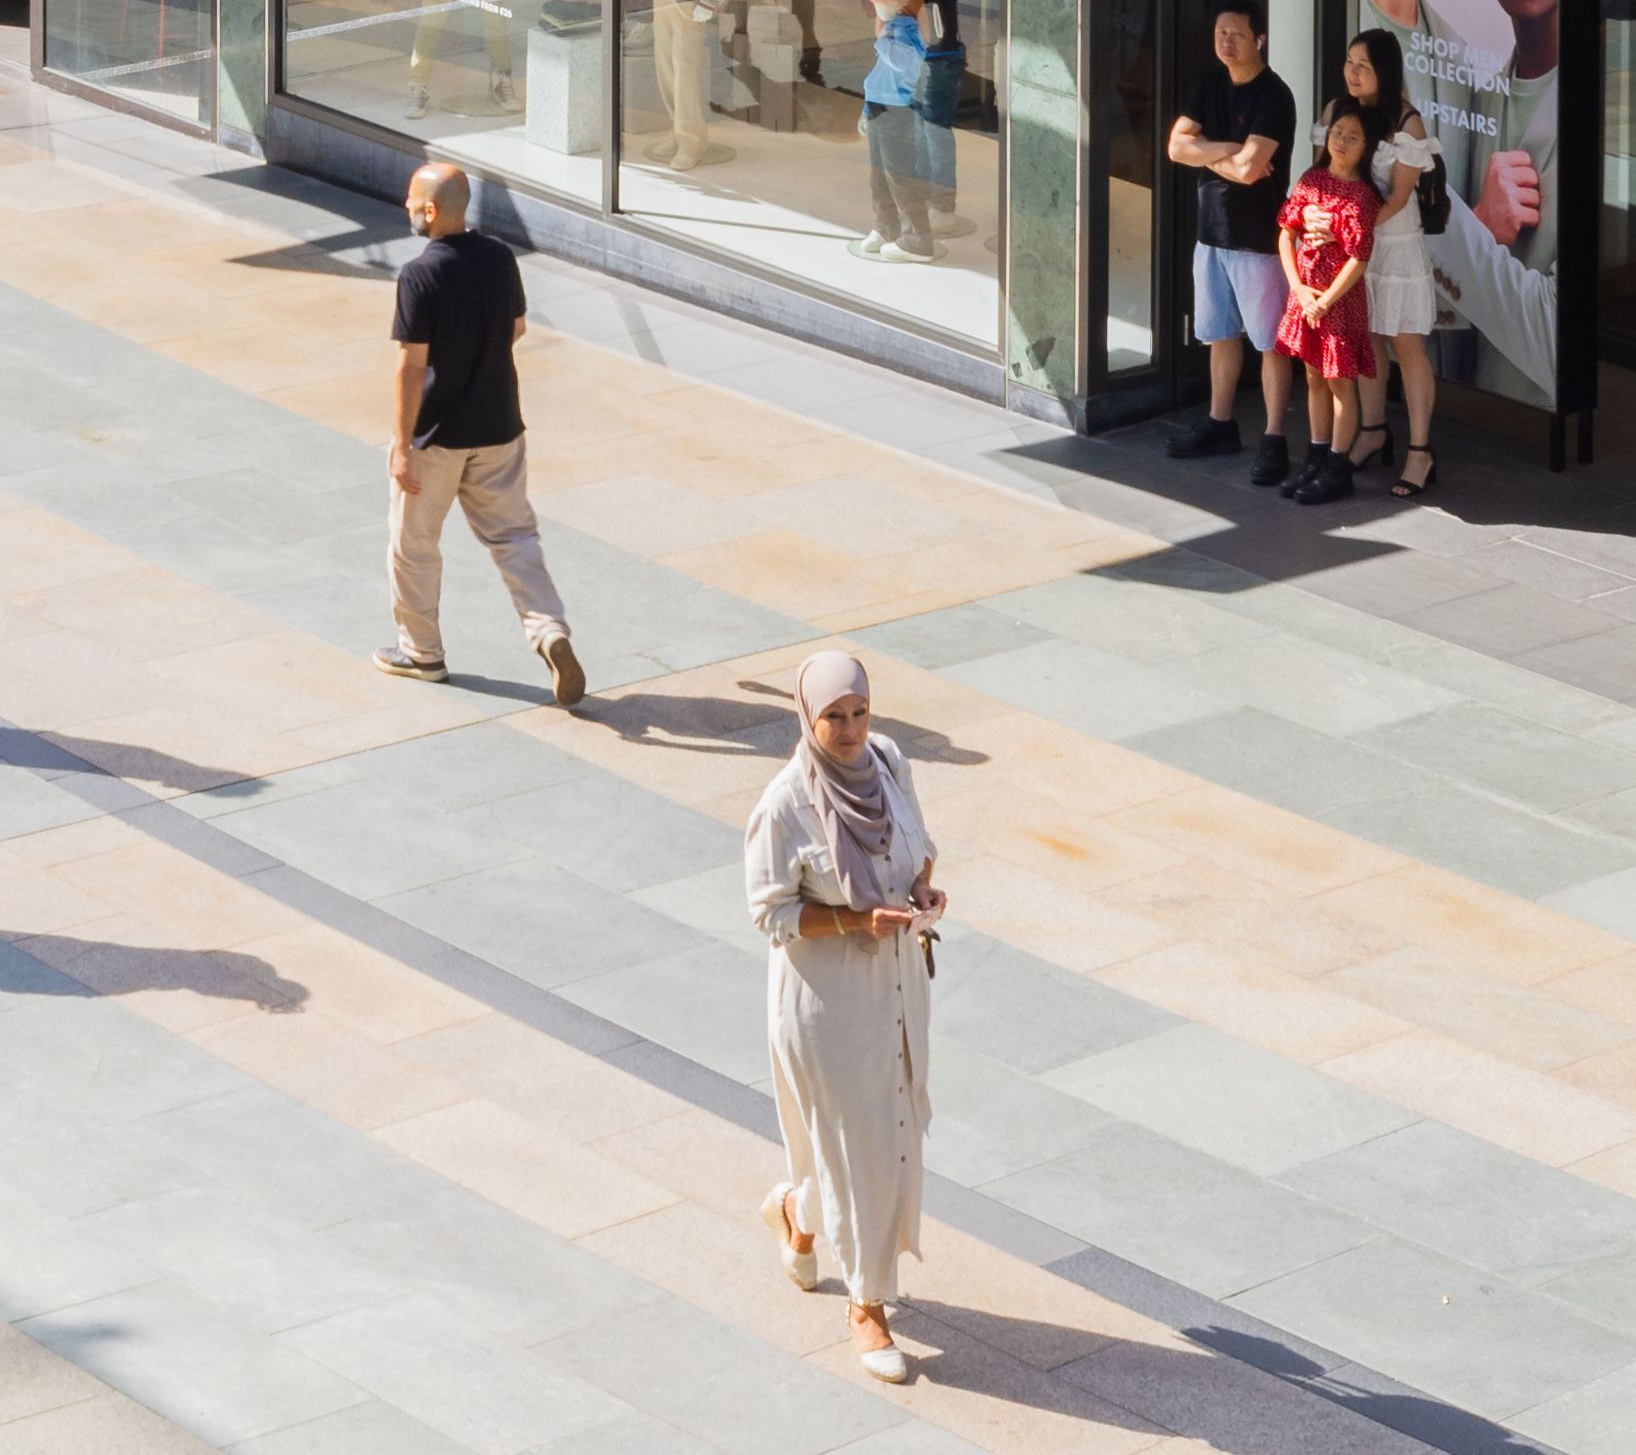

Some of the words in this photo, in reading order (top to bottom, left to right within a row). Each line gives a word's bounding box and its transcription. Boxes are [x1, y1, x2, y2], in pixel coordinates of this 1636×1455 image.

[1409, 33, 1460, 61] SHOP
[1463, 44, 1505, 74] MEN
[1403, 51, 1511, 98] COLLECTION
[1418, 98, 1498, 138] UPSTAIRS
